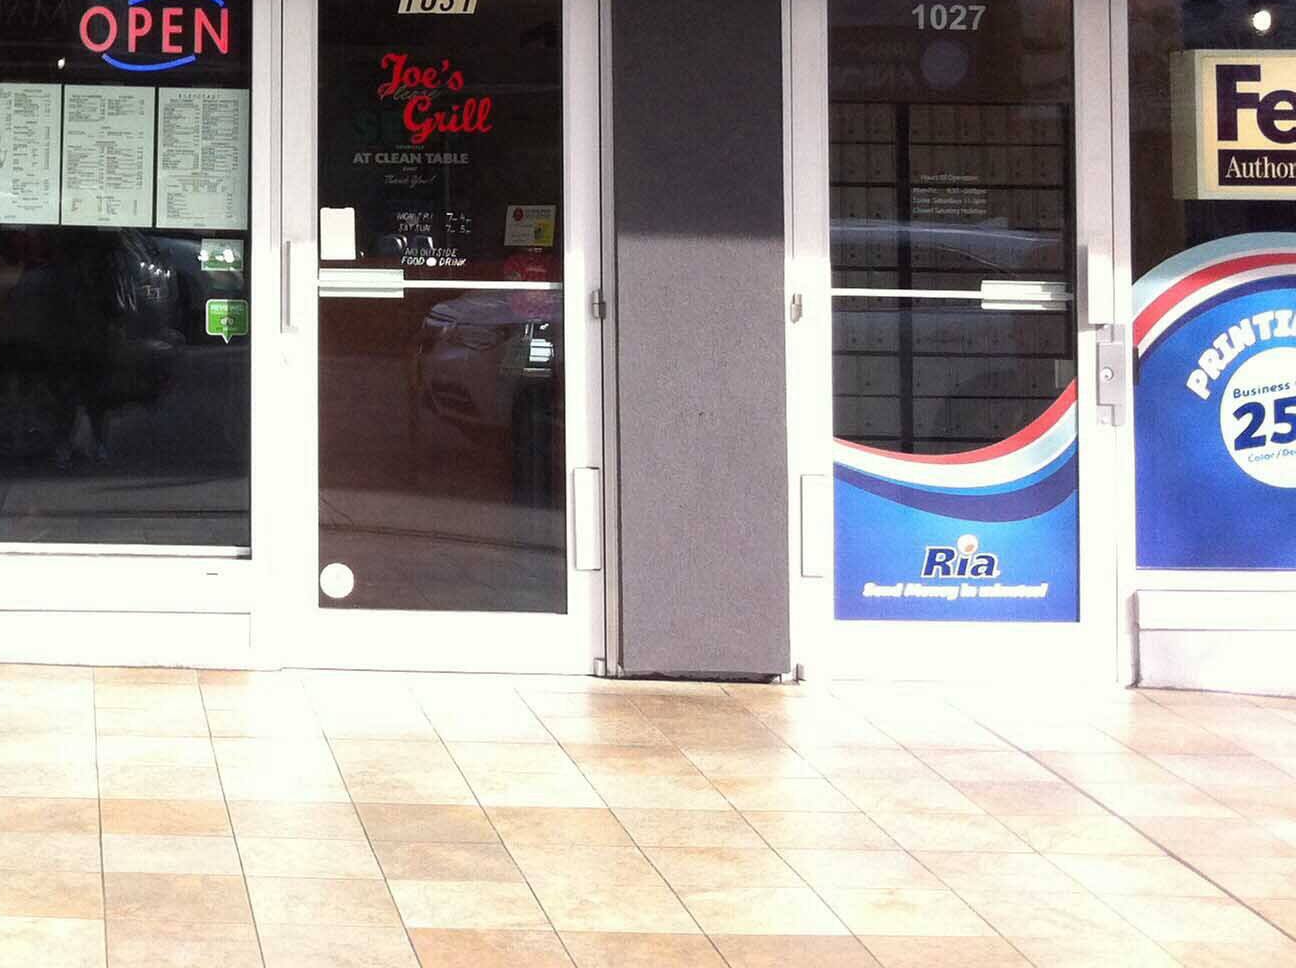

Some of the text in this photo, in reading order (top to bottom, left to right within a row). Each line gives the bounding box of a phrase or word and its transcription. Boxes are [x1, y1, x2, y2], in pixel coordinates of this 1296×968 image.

[79, 5, 229, 56] OPEN
[911, 3, 987, 31] 1027
[377, 52, 464, 99] Joe's
[404, 95, 493, 144] Grill
[1215, 64, 1296, 145] Fe
[353, 152, 469, 165] AT CLEAN TABLE
[401, 256, 425, 265] FOOD
[1186, 309, 1296, 401] PRINTI
[1233, 382, 1291, 399] Business
[921, 534, 1000, 578] Ria
